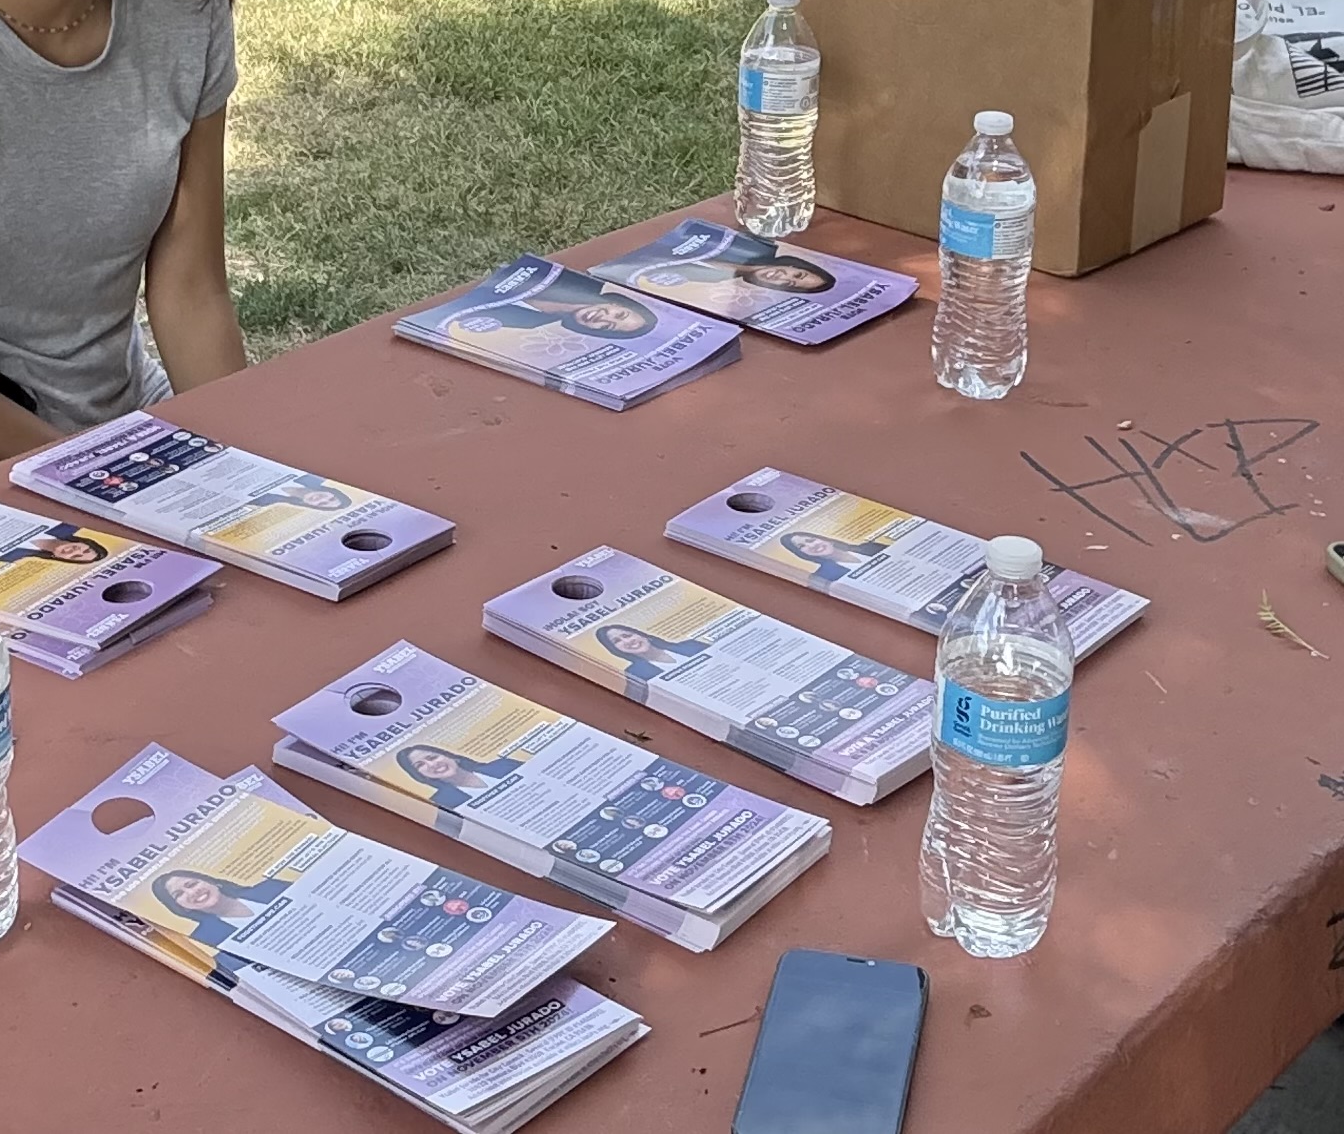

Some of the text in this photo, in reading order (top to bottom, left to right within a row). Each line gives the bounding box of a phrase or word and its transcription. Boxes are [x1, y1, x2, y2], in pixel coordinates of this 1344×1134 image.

[789, 282, 893, 334] YSABEL JURADO
[595, 354, 661, 388] JURADO
[651, 323, 716, 359] YSABEL
[651, 355, 685, 372] VOTE
[267, 495, 387, 560] YSABEL JURADO
[733, 485, 837, 546] YSABEL JURADO
[23, 546, 156, 621] YSABEL JURADO
[556, 573, 675, 637] YSABEL JURADO
[342, 674, 481, 761] YSABEL JURADO
[980, 704, 1042, 721] Purified
[980, 718, 1046, 736] Drinking
[118, 749, 172, 786] YSABEL
[90, 840, 172, 895] YSABEL
[156, 783, 244, 842] JURADO
[648, 810, 757, 886] VOTE YSABEL JURADO
[433, 920, 547, 1003] VOTE YSABEL JURADO
[412, 1057, 455, 1083] VOTE
[450, 1029, 508, 1063] YSABEL
[502, 998, 563, 1034] JURADO
[425, 1073, 449, 1088] ON
[445, 1036, 518, 1079] NOVEMBER
